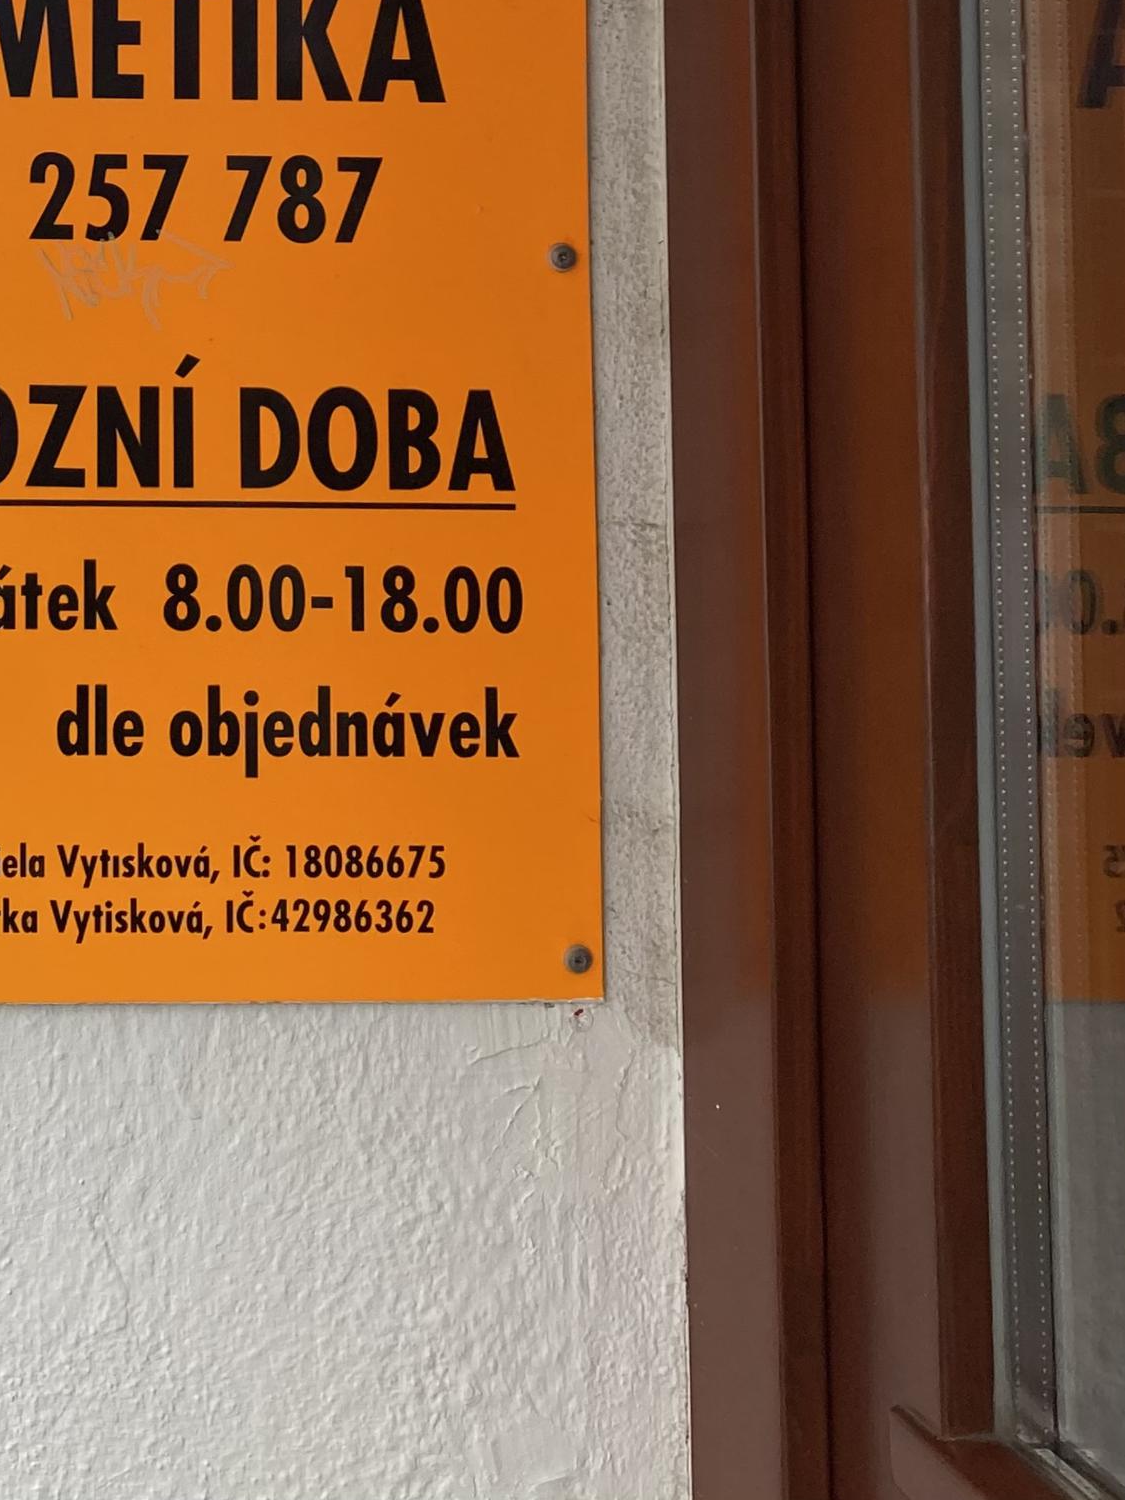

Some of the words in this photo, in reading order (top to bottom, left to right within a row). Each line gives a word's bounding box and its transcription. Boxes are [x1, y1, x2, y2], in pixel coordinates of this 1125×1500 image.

[29, 153, 189, 242] 257
[223, 154, 383, 244] 787
[239, 386, 516, 492] DOBA
[163, 563, 523, 635] 8.00-18.00
[56, 684, 145, 757] dle
[169, 684, 520, 779] objednávek
[233, 835, 271, 878] IČ:
[286, 844, 446, 879] 18086675
[49, 897, 213, 941] Vytisková,
